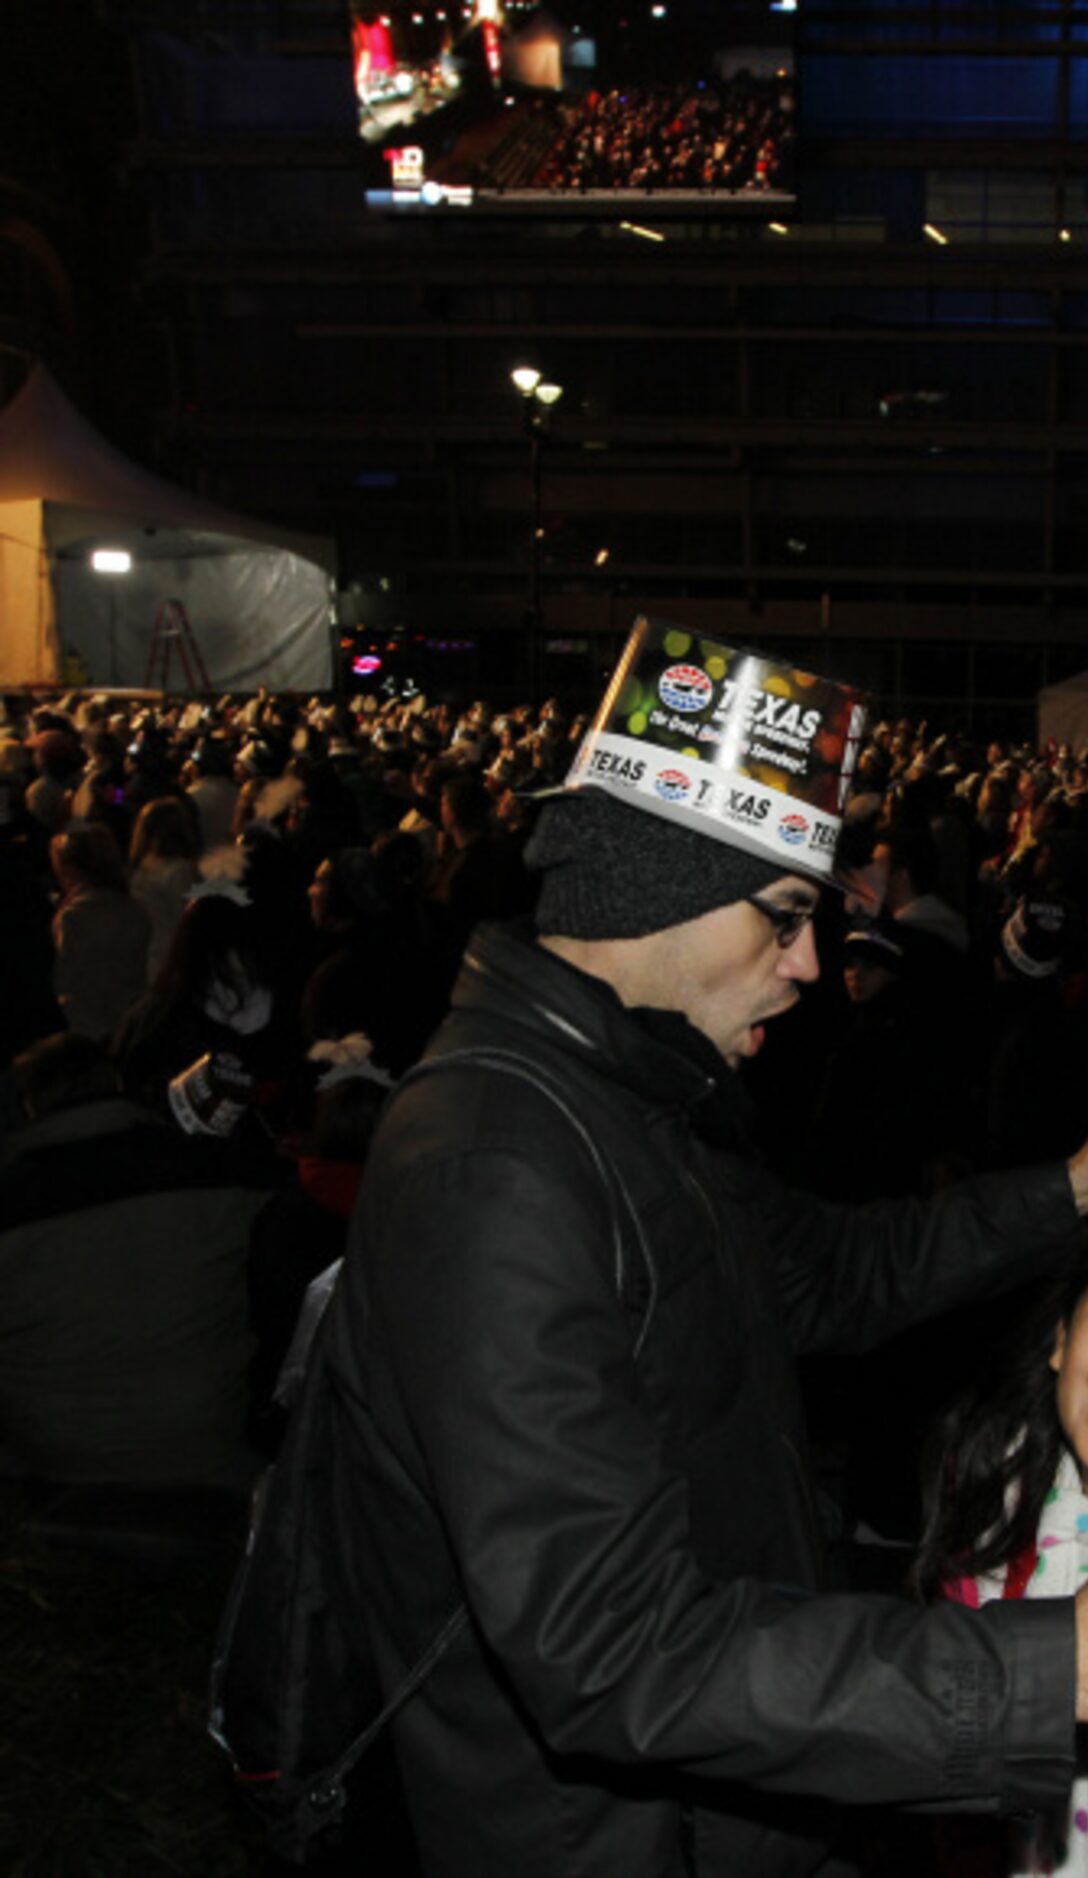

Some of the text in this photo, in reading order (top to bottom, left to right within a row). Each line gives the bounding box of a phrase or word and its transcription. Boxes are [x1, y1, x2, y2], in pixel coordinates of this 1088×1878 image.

[717, 679, 822, 739] TEXAS
[592, 750, 646, 782] TEXAS
[697, 779, 771, 820] TXAS
